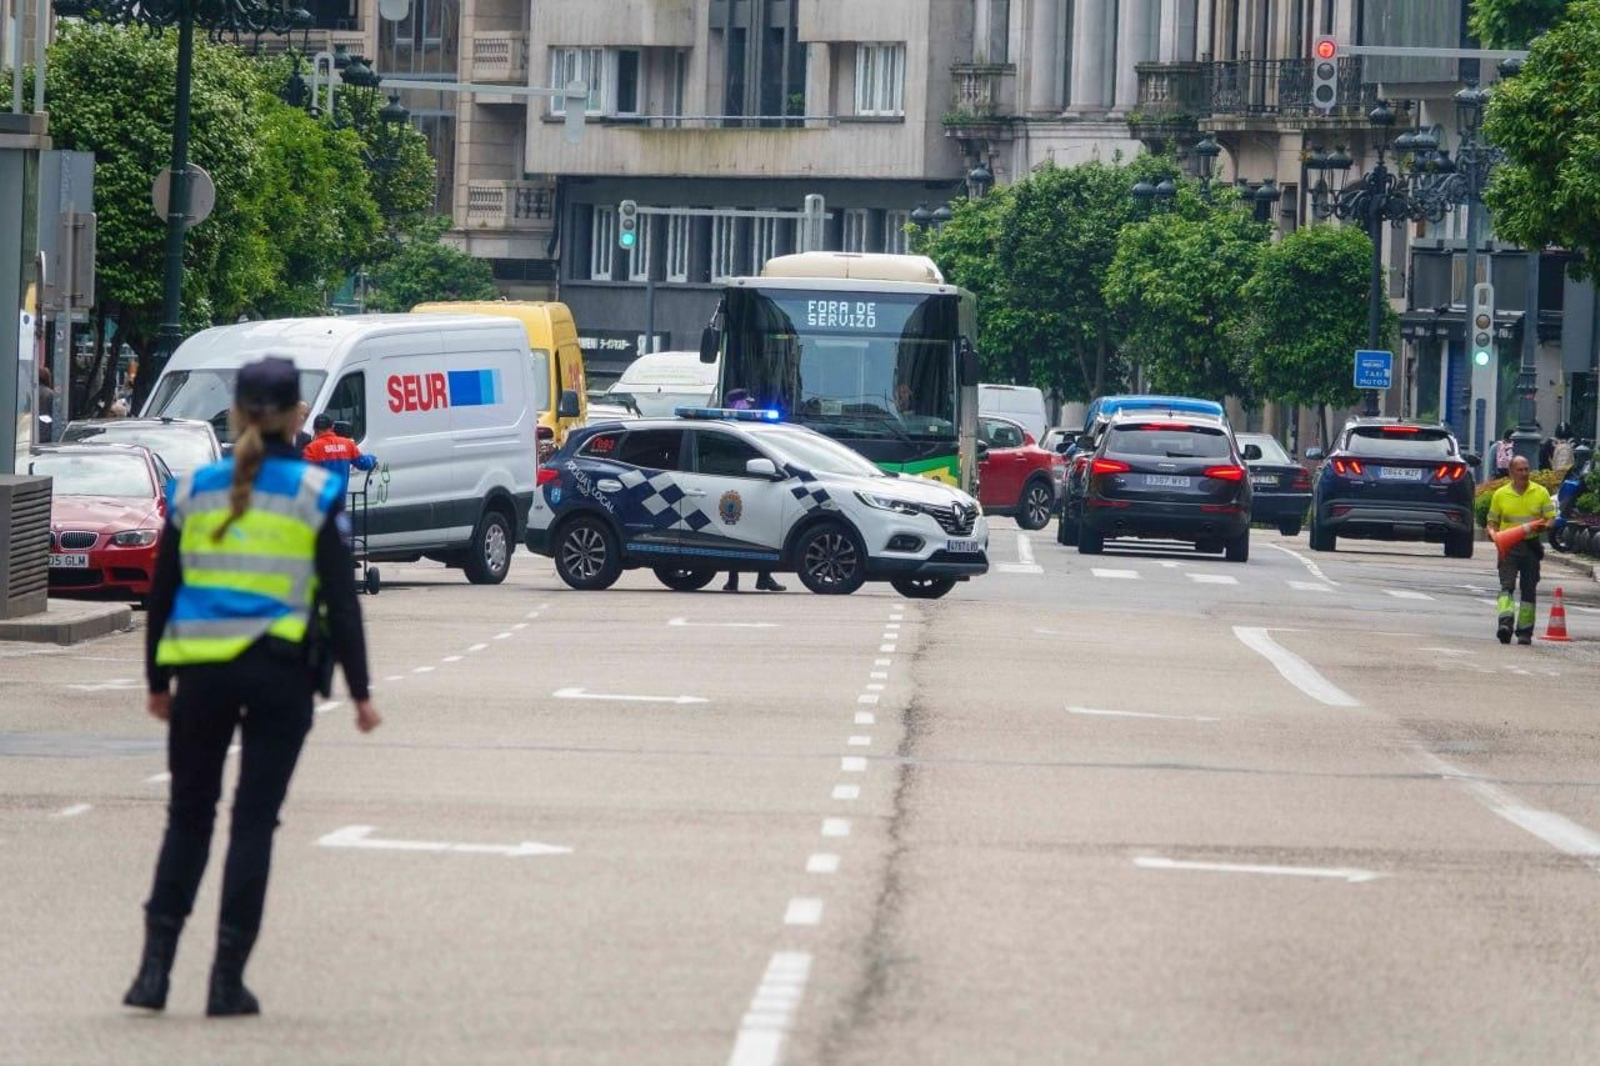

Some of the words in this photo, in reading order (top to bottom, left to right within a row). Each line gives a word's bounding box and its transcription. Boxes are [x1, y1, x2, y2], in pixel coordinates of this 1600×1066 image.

[808, 300, 848, 315] FORA
[856, 302, 876, 316] DE
[808, 313, 876, 329] SERVIZO
[386, 373, 448, 413] SEUR
[591, 486, 615, 514] LOCAL
[65, 555, 86, 566] GLM
